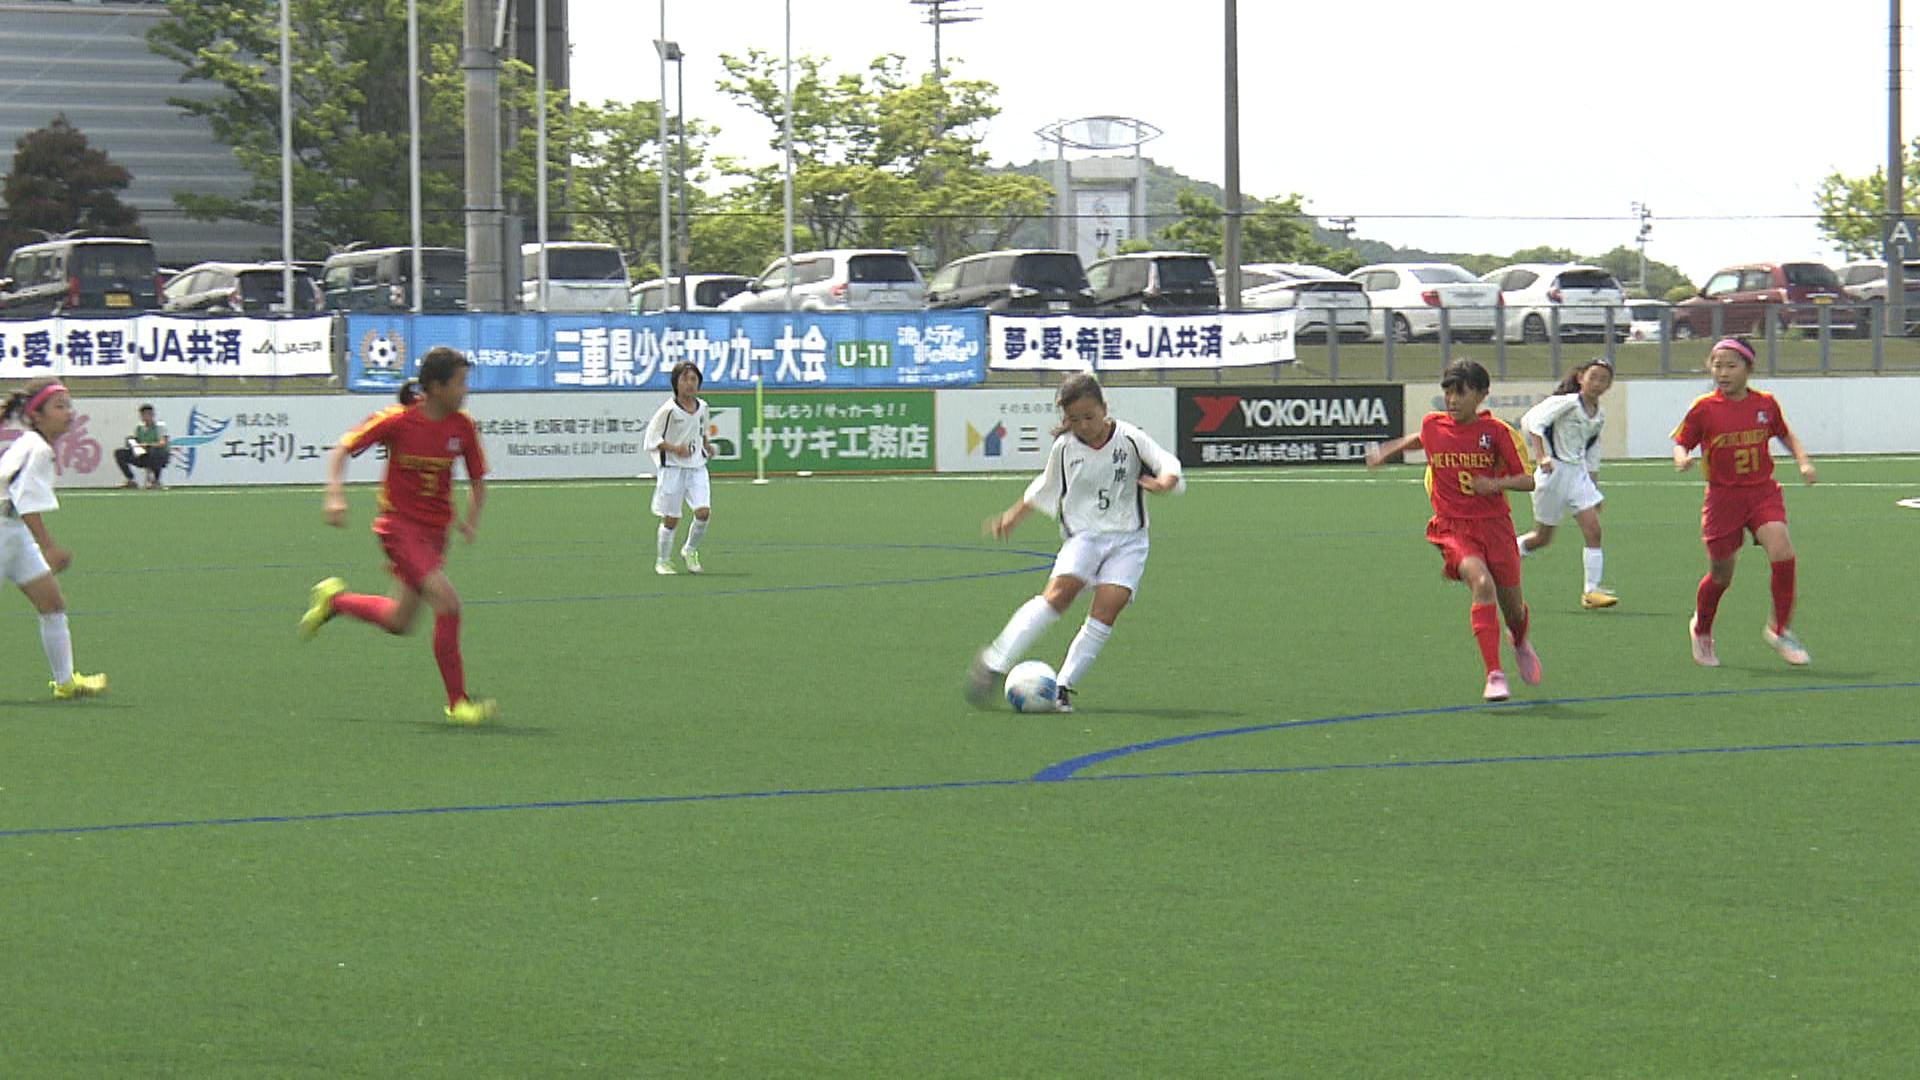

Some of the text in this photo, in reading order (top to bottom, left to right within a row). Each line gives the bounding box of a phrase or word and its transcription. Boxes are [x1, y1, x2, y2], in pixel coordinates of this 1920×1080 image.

[1888, 221, 1912, 242] A
[0, 327, 242, 367] ・愛・希望・JA共済
[554, 324, 827, 386] 三重県少年サッカー大会
[838, 343, 889, 368] U-11
[1004, 325, 1222, 362] 夢・愛・希望・JA共済
[1239, 397, 1390, 429] YOKOHAMA
[747, 423, 930, 460] ササキ工務店
[1734, 449, 1760, 475] 21
[1098, 488, 1110, 511] 5
